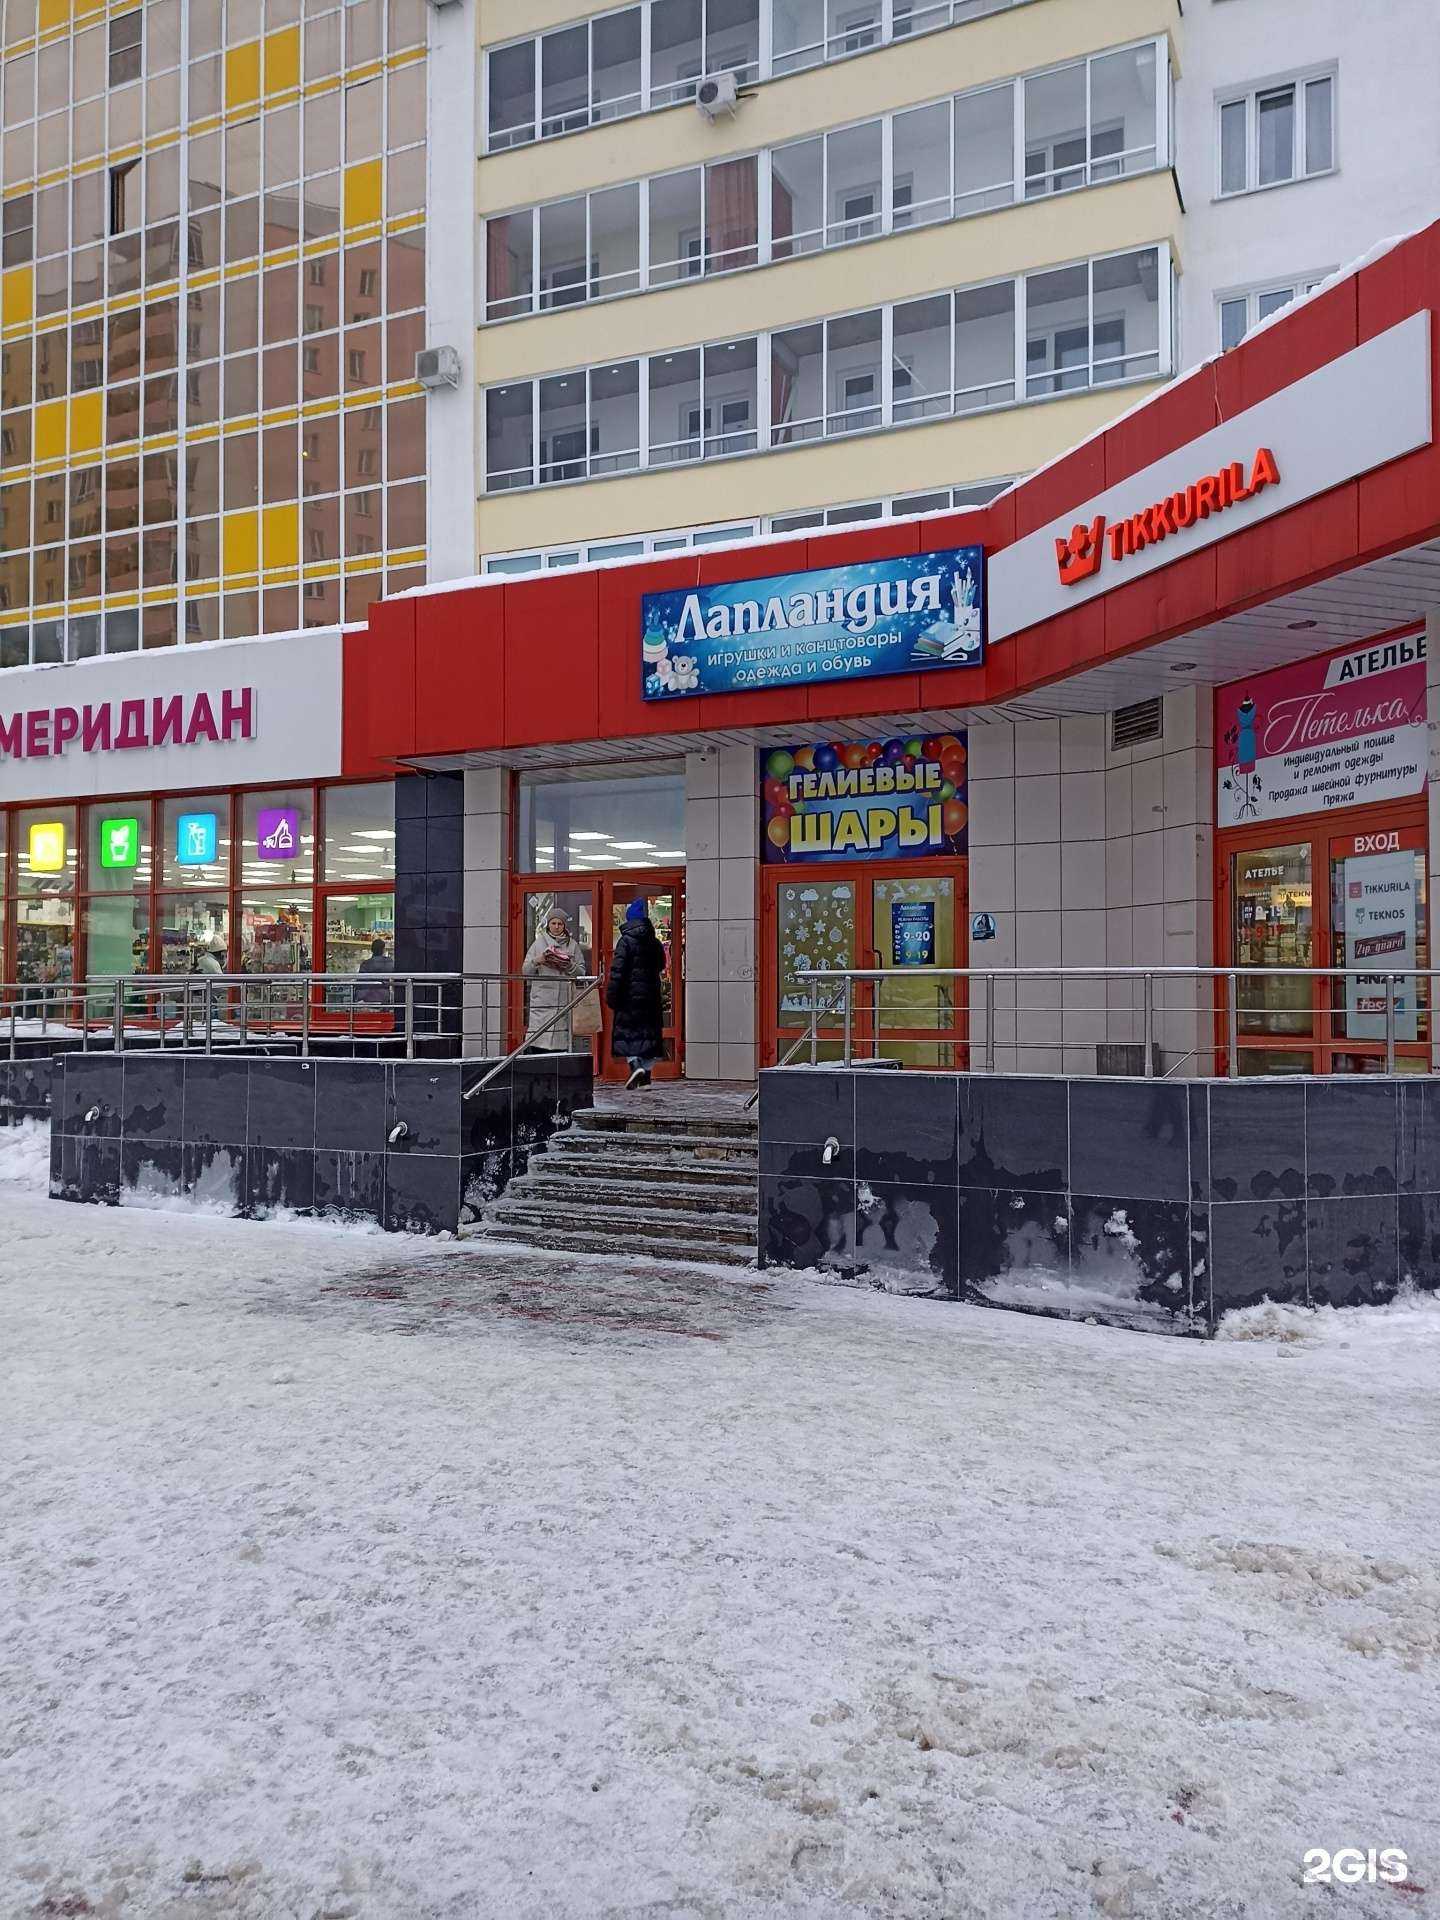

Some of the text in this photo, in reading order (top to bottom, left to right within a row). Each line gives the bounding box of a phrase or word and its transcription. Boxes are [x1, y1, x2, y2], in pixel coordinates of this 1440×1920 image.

[1106, 448, 1281, 561] TIKKURILA
[674, 574, 942, 643] Лапландия
[707, 631, 902, 668] игрушки и канцтовары
[1339, 636, 1427, 681] АТЕЛЬЕ
[736, 655, 872, 682] одежда и обувь
[0, 687, 253, 758] МЕРИДИАН
[1263, 692, 1409, 754] Петелька
[1283, 734, 1395, 767] Индивидуальный пошив
[1293, 752, 1384, 780] и ремонт одежды
[788, 763, 942, 800] ГЕЛИЕВЫЕ
[1268, 763, 1418, 802] Продажа швейной фурнитуры
[1323, 791, 1355, 807] Пряжа
[790, 803, 945, 854] ШАРЫ
[1354, 832, 1400, 853] ВХОД
[1245, 865, 1284, 880] АТЕЛЬЕ
[1364, 881, 1411, 895] TIKKURILA
[1288, 889, 1312, 898] TEKN
[1368, 909, 1406, 921] TEKNOS
[903, 931, 931, 941] 9-20
